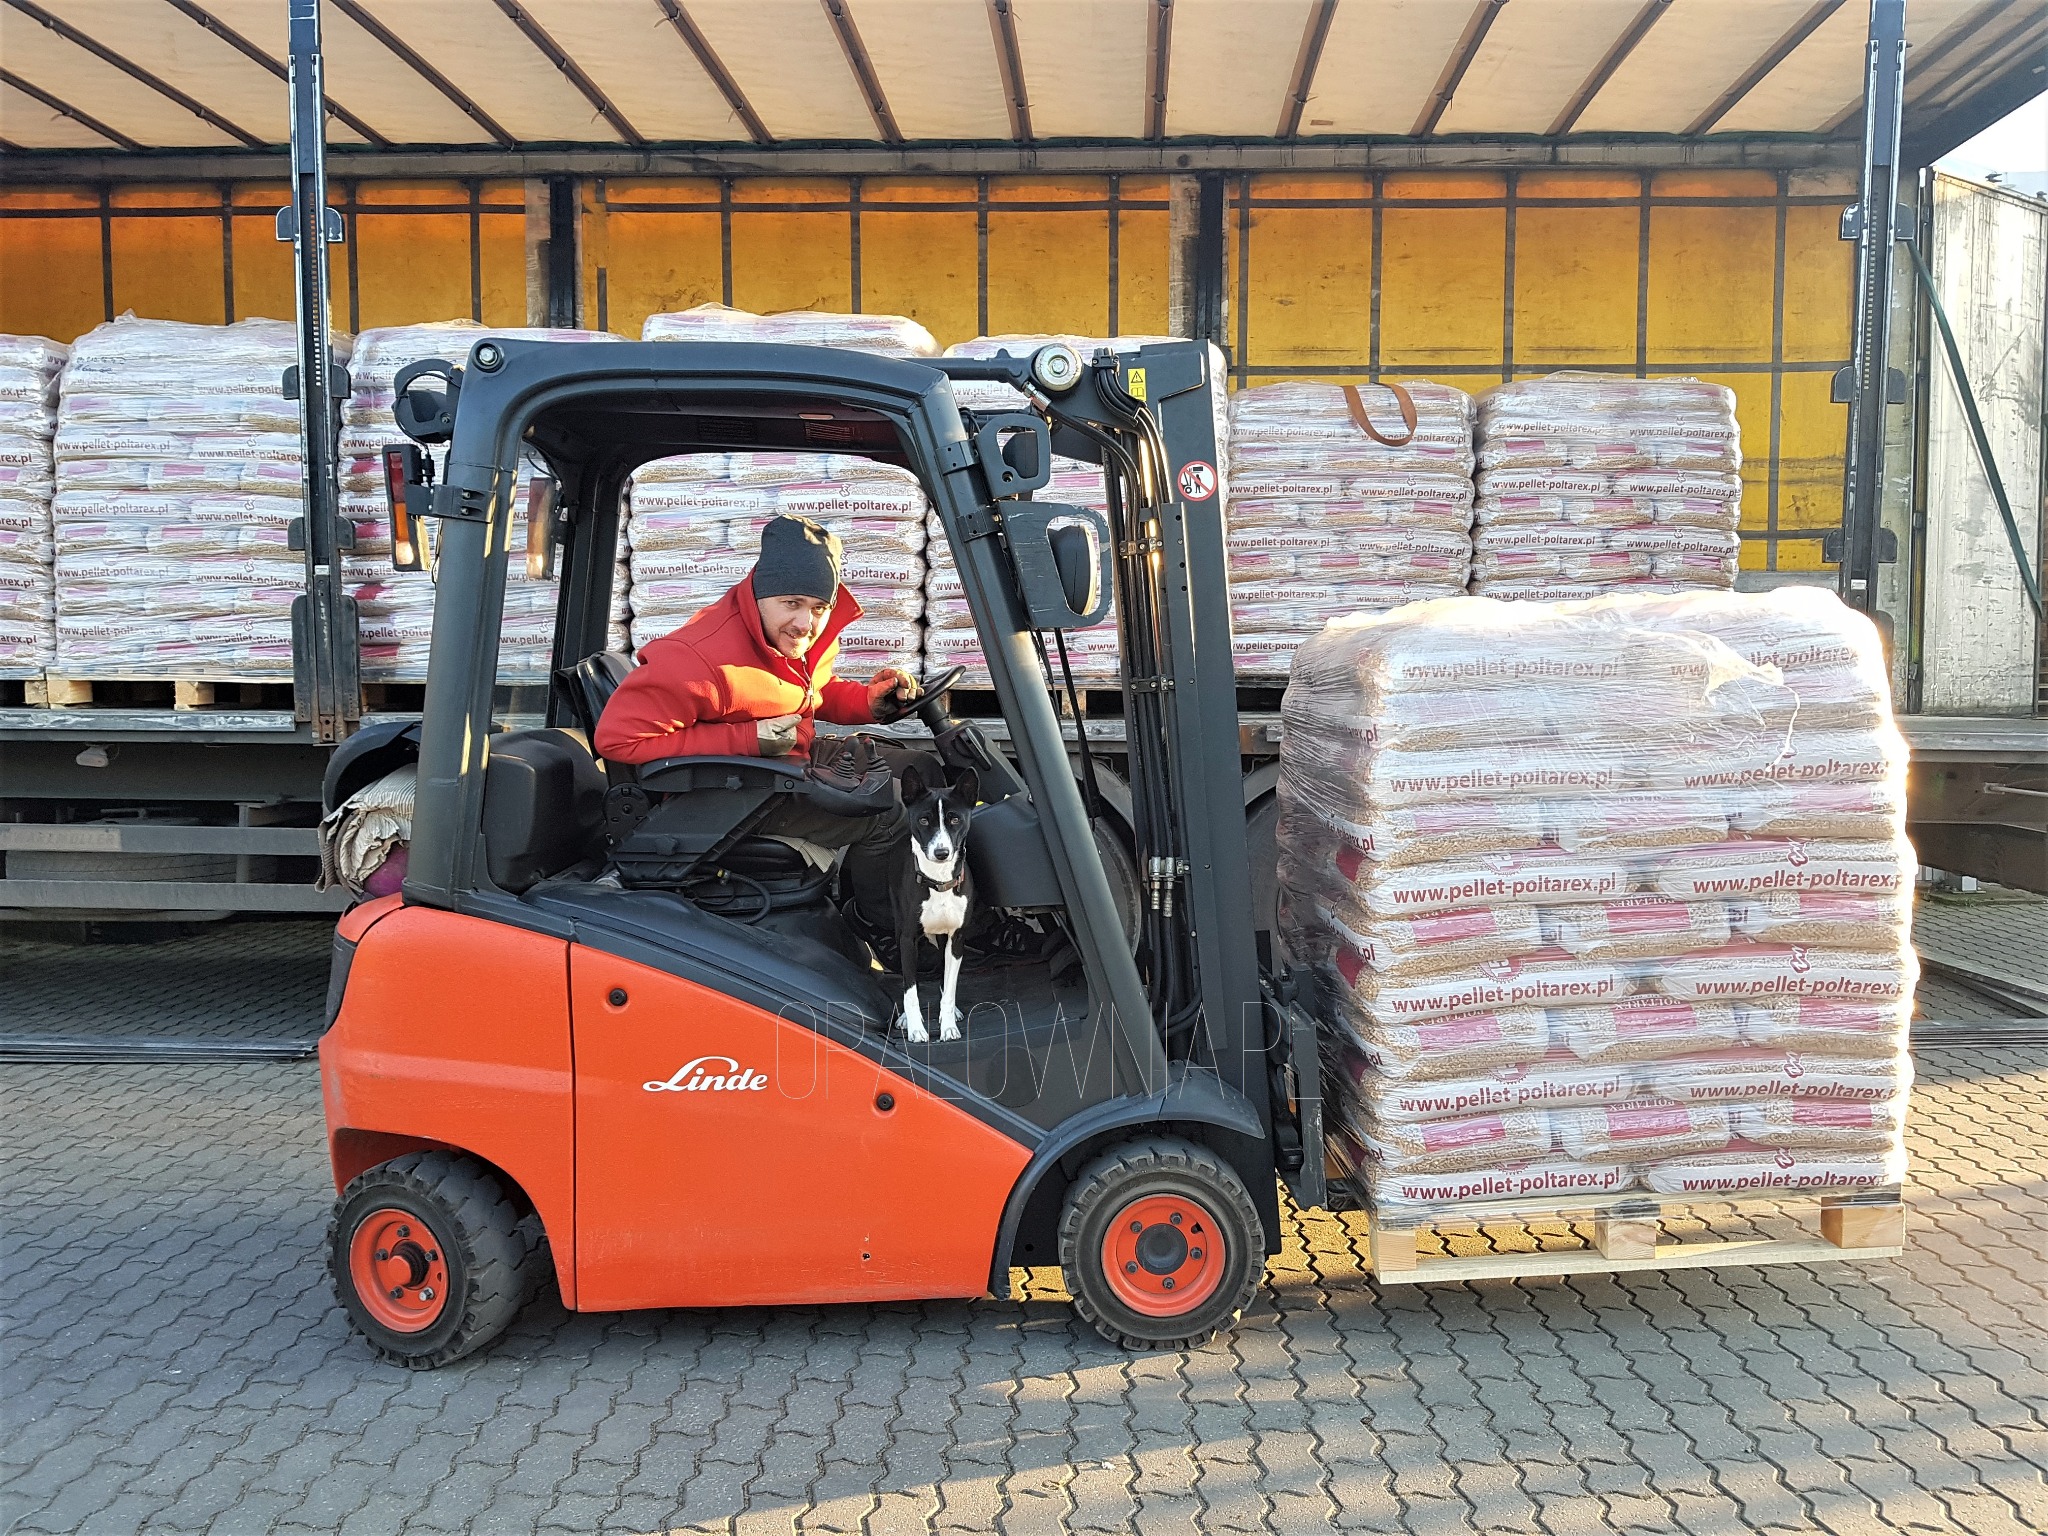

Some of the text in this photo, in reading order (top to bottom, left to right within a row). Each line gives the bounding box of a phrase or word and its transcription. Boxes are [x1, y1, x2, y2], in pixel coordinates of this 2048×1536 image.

[1492, 479, 1601, 492] www.pellet-poltarex.pl
[787, 499, 912, 512] www.pellet-poltarex.pl
[1359, 541, 1466, 556] www.pellet-poltarex.pl
[1487, 534, 1596, 547] www.pellet-poltarex.pl
[639, 563, 751, 576] www.pellet-poltarex.
[1230, 589, 1328, 601] ww.pellet-poltarex.pl
[1390, 766, 1614, 793] www.pellet-poltarex.pl
[1393, 871, 1617, 904] www.pellet-poltarex.pl
[1391, 974, 1615, 1013] www.pellet-poltarex.pl
[642, 1055, 768, 1092] Linde
[1400, 1075, 1620, 1112] www.pellet-poltarex.pl
[1402, 1166, 1620, 1200] www.pellet-poltarex.pl
